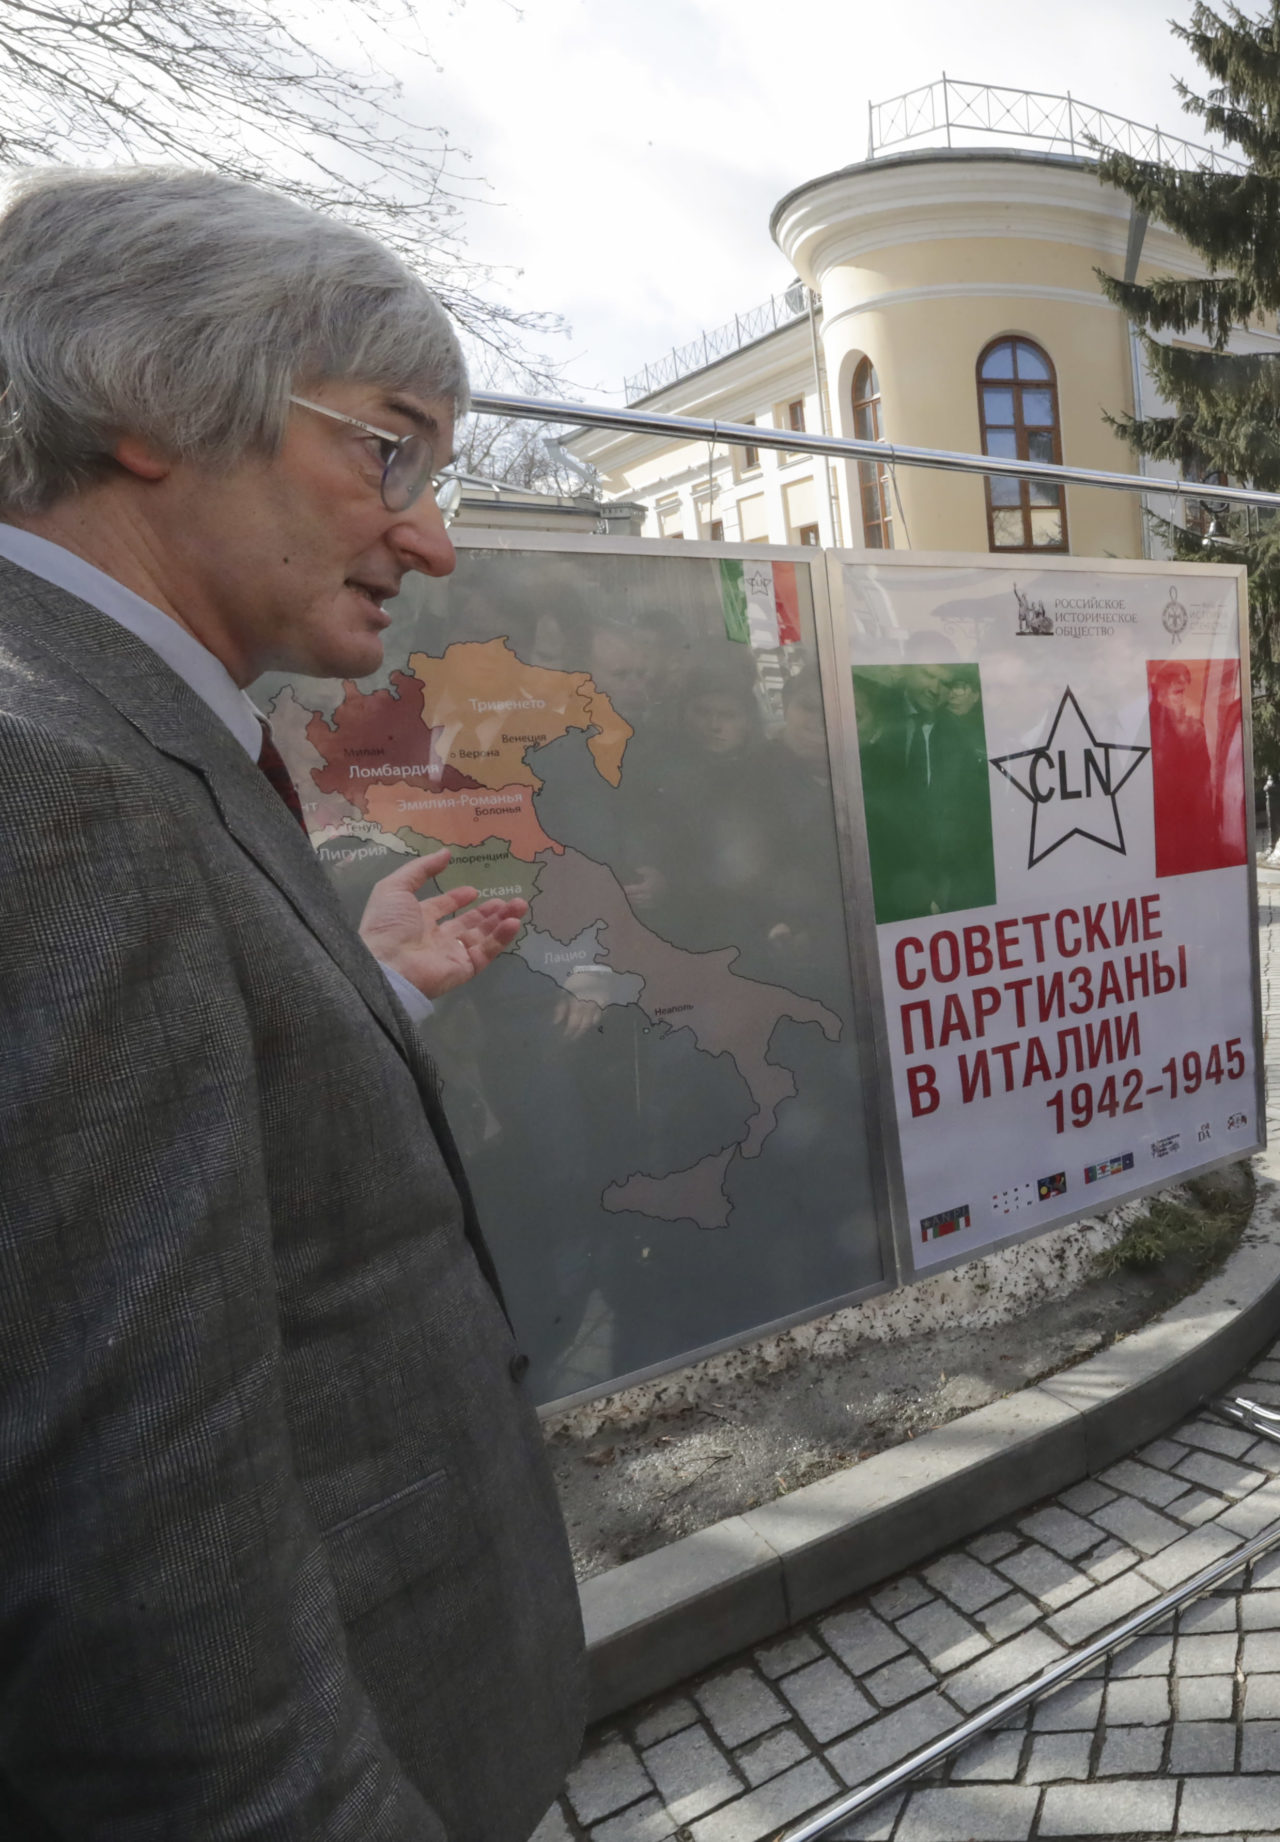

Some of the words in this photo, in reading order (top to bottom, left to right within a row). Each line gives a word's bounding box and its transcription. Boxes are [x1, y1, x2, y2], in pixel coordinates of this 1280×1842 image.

[1054, 596, 1126, 611] РОССИЙСКОЕ
[1054, 611, 1138, 625] ИСТОРИЧЕСКОЕ
[1054, 625, 1115, 639] ОБЩЕСТВО
[502, 732, 547, 745] Венеция
[343, 746, 386, 758] Милан
[458, 748, 500, 760] Верона
[348, 763, 440, 779] Ломбардия
[1029, 747, 1112, 803] CLN
[397, 792, 523, 813] Эмилия-Романья
[474, 805, 522, 818] Болонья
[319, 845, 388, 862] Лигурия
[478, 884, 523, 898] скана
[894, 893, 1163, 991] СОВЕТСКИЕ
[543, 949, 587, 964] Лацио
[899, 944, 1188, 1056] ПАРТИЗАНЫ
[654, 1002, 695, 1017] Неаполь
[906, 1063, 941, 1119] В
[957, 1011, 1141, 1105] ИТАЛИИ
